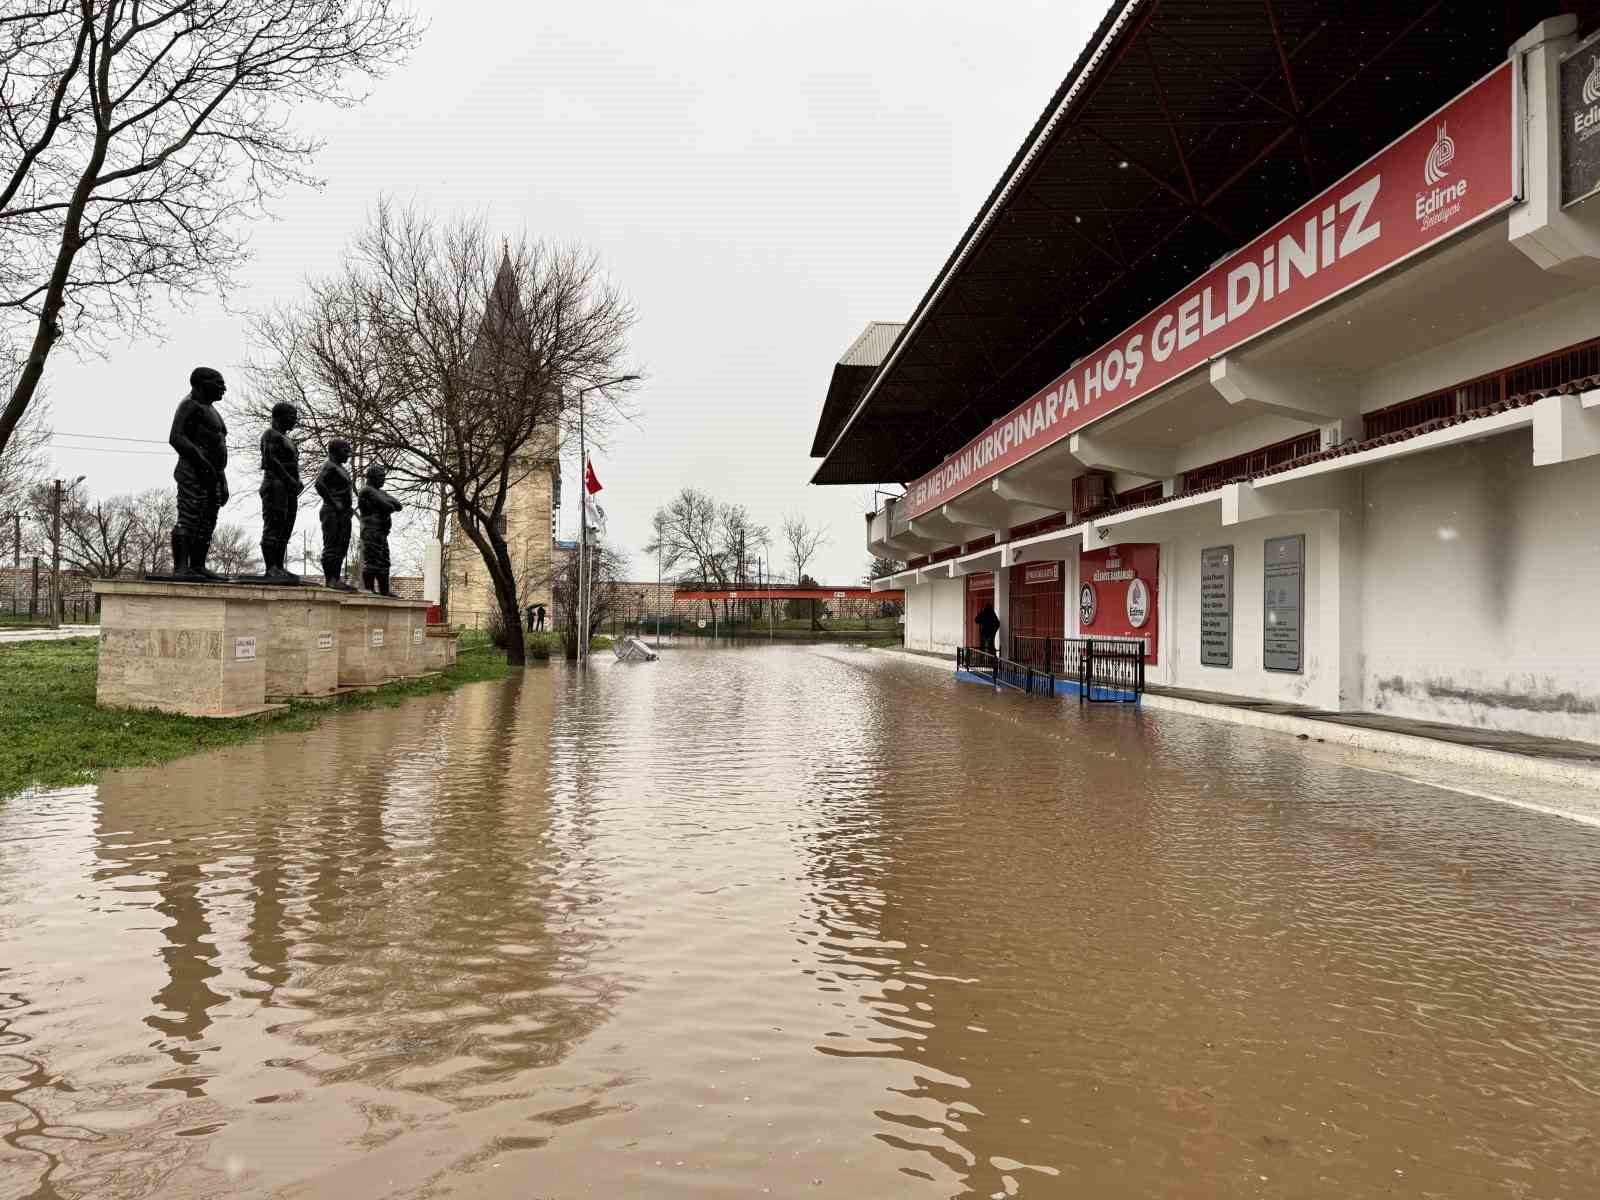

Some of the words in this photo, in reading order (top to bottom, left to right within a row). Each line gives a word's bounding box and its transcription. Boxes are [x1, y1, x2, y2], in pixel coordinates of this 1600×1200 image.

[1416, 179, 1467, 220] Edirne
[916, 480, 928, 506] ER
[927, 451, 971, 498] MEYDANI
[973, 378, 1079, 471] KIRKPINAR'A
[1084, 334, 1144, 405] HOŞ
